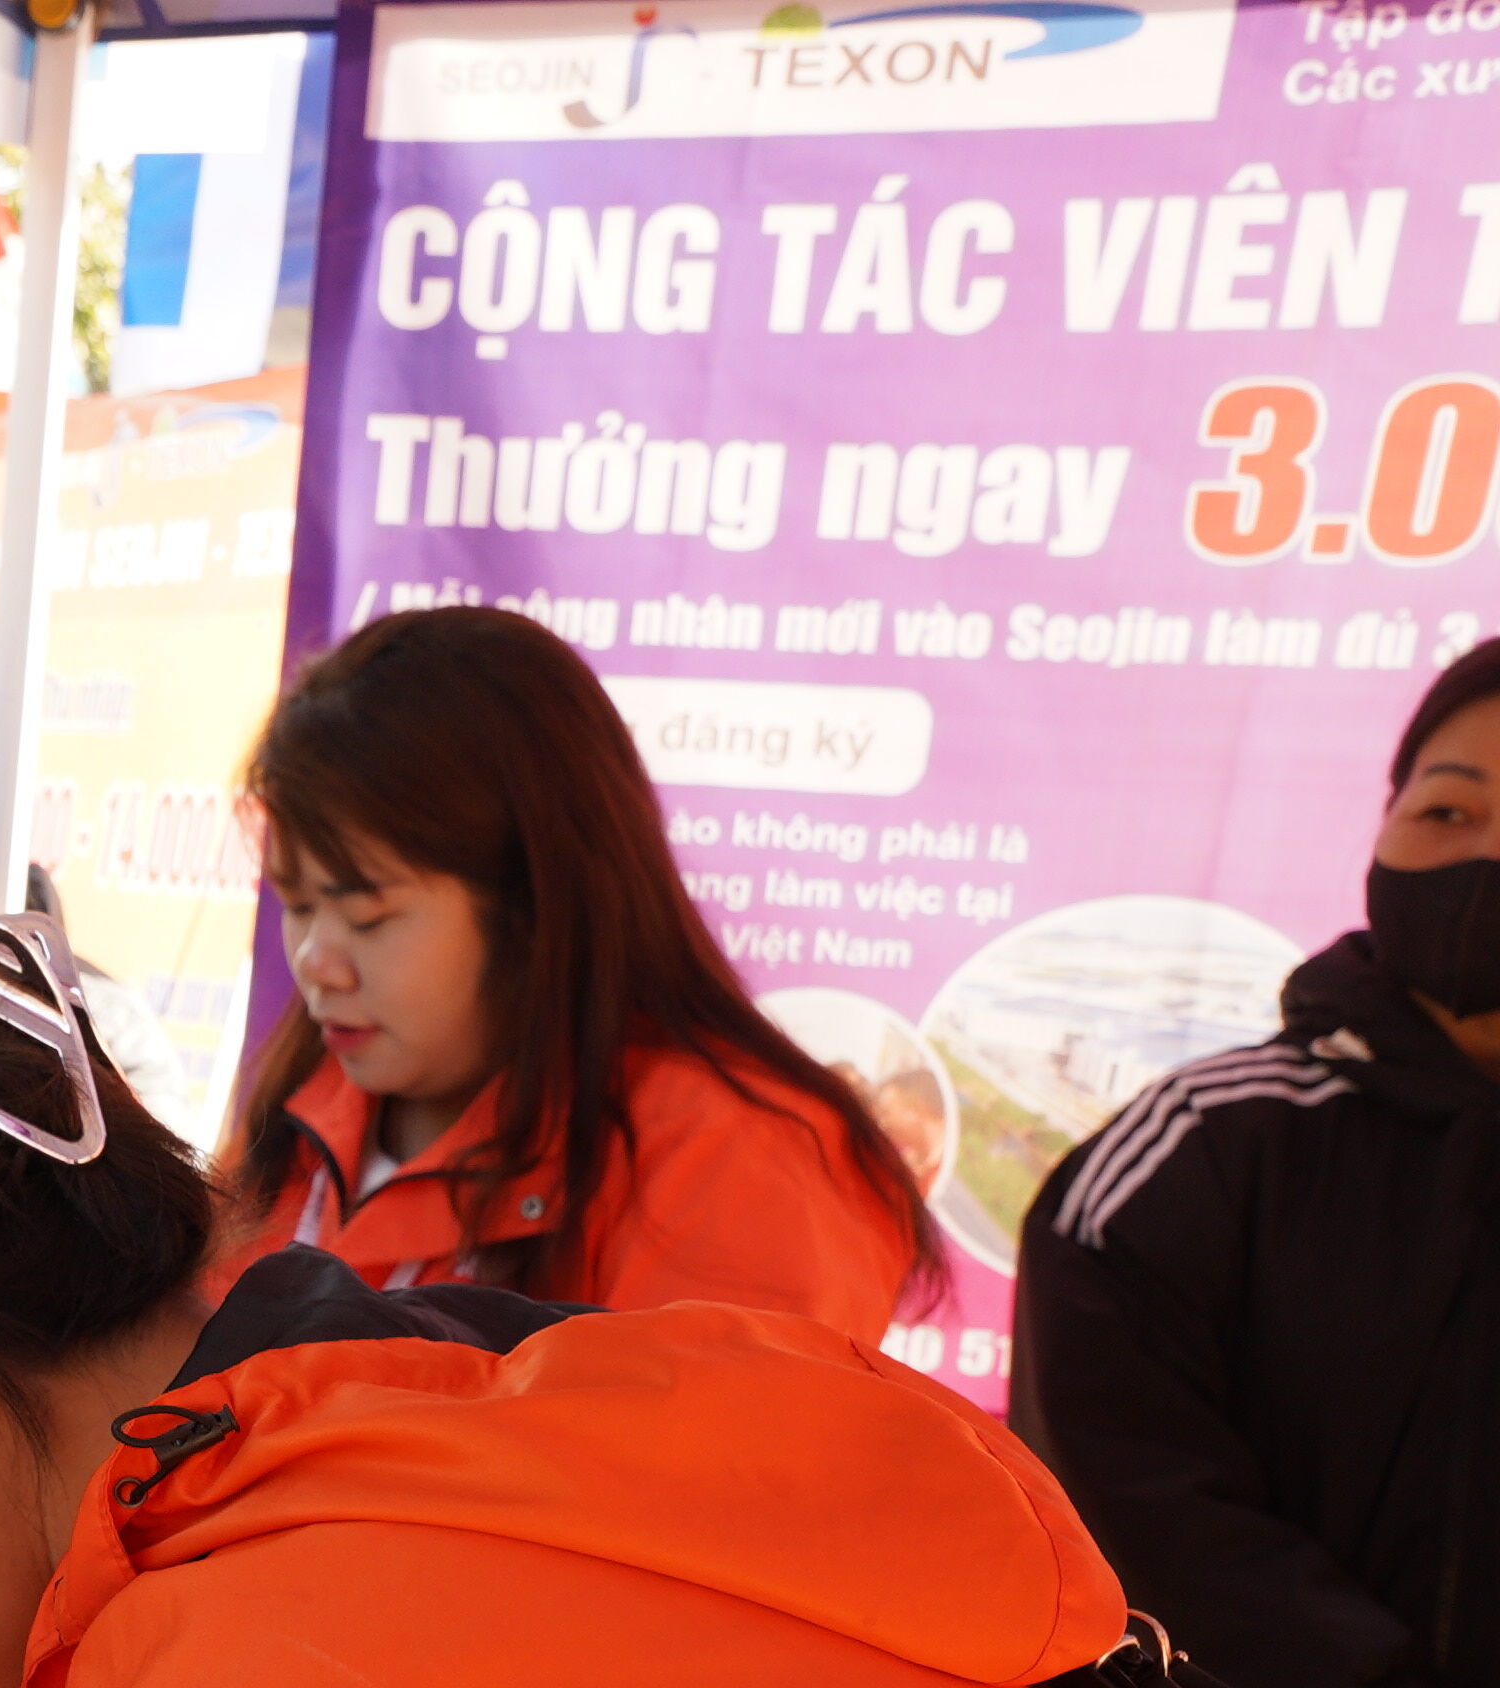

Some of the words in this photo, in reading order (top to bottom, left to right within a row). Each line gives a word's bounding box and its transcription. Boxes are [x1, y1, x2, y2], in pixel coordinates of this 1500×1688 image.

[743, 38, 992, 88] TEXON
[1283, 60, 1396, 105] Các
[376, 179, 721, 360] CỘNG
[761, 173, 1015, 336] TÁC
[1063, 161, 1408, 334] VIÊN
[364, 408, 788, 553] Thưởng
[815, 438, 1132, 559] ngay
[628, 593, 764, 650] nhân
[773, 598, 883, 654] mới
[894, 600, 994, 660] vào
[1003, 603, 1193, 669] Seojin
[1203, 606, 1321, 668] làm
[1331, 606, 1421, 670] đủ
[731, 809, 868, 863] không
[877, 816, 978, 864] phải
[988, 821, 1030, 863] là
[763, 867, 841, 910] làm
[853, 871, 946, 922] việc
[954, 881, 1015, 924] tại
[719, 921, 803, 969] Việt
[813, 924, 913, 969] Nam
